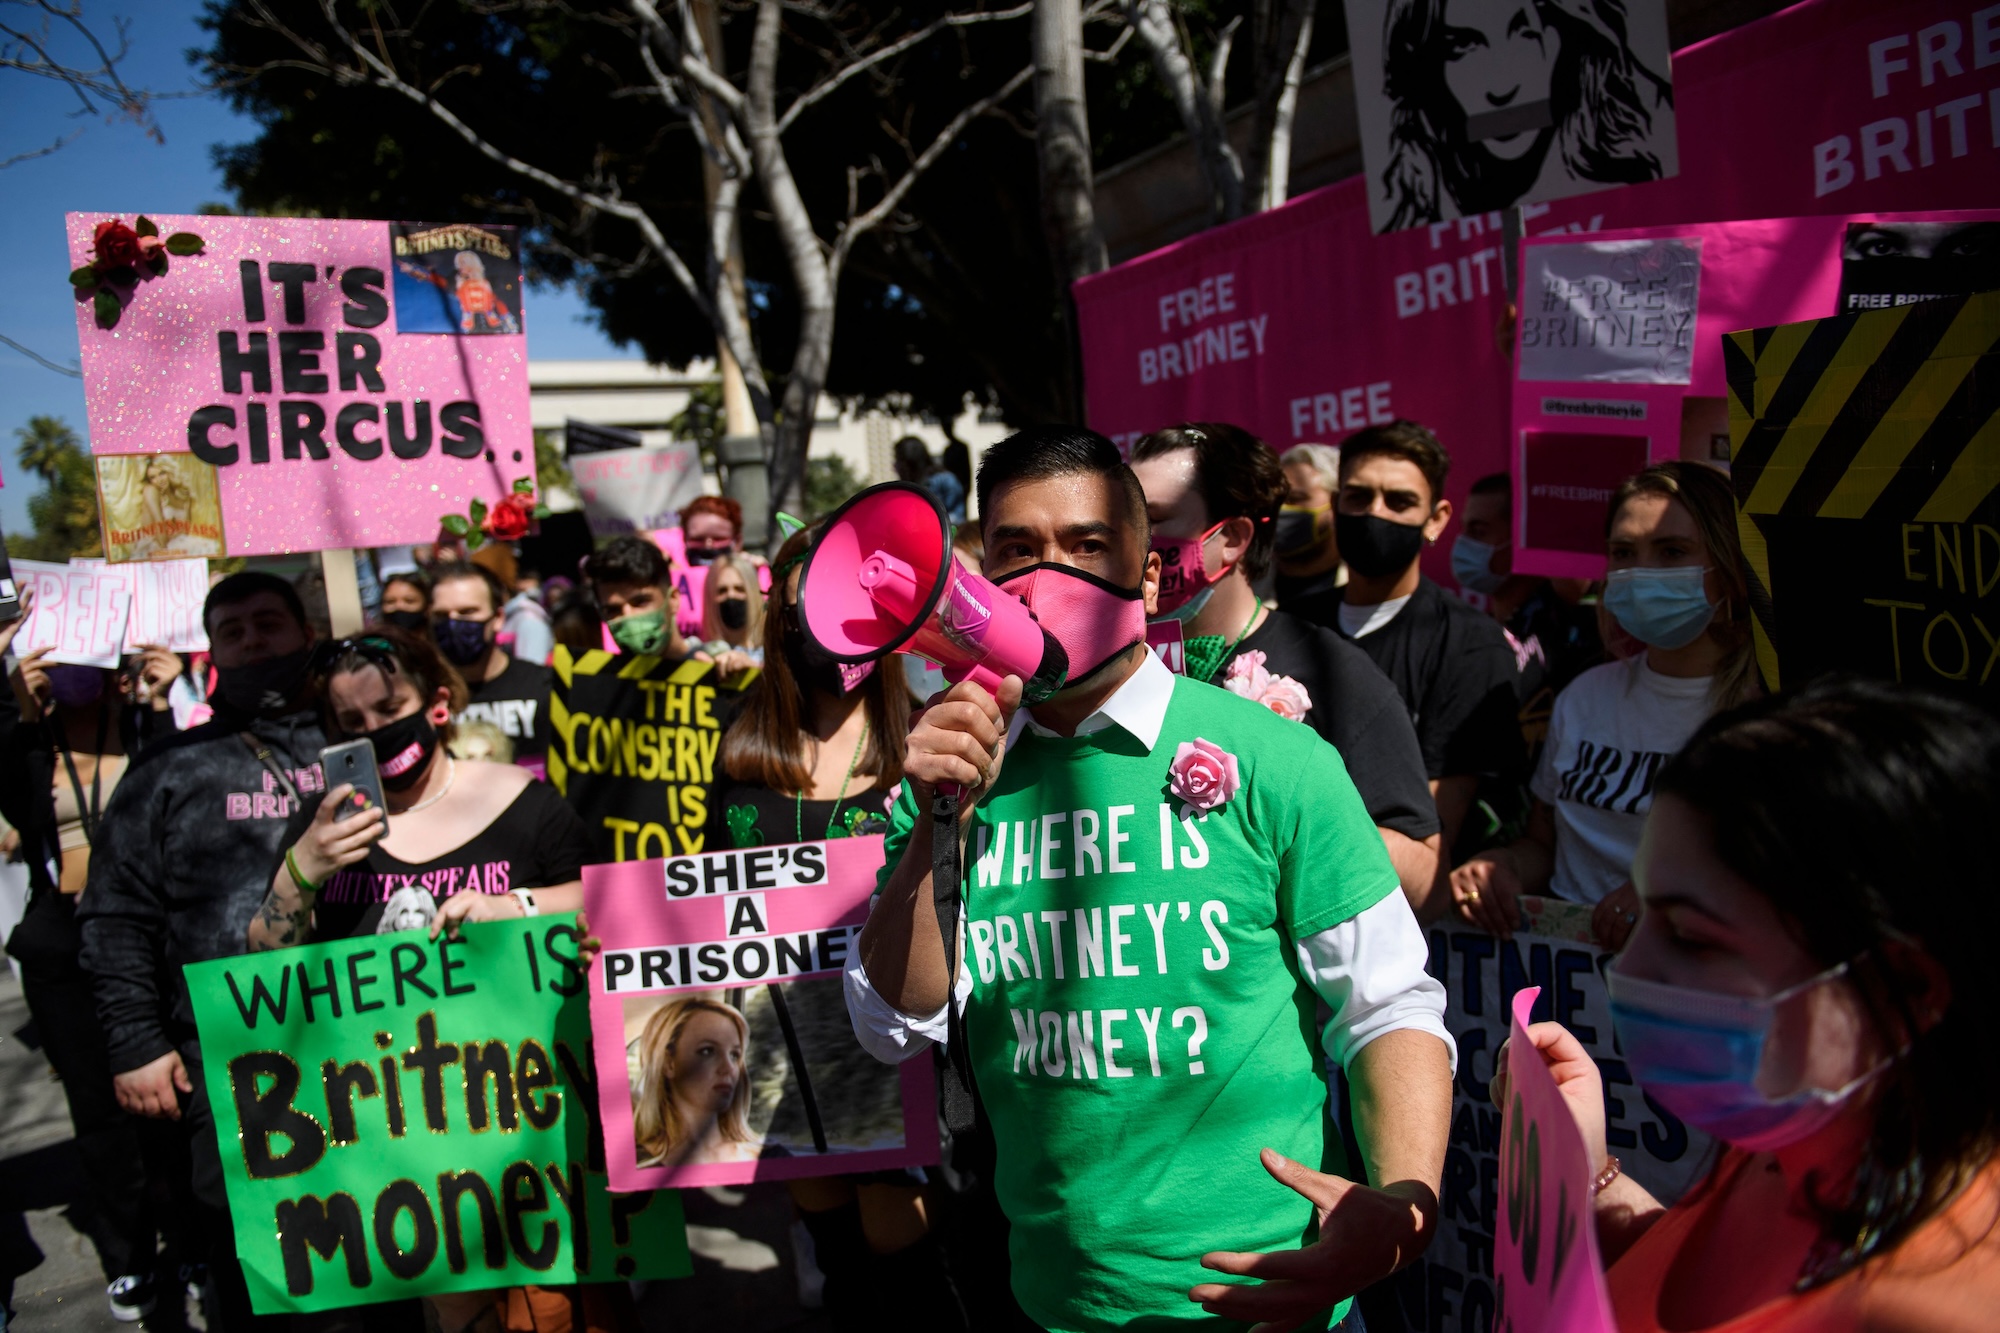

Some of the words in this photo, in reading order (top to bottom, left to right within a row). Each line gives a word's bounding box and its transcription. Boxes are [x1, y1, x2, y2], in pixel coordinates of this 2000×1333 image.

[1813, 88, 2000, 199] BRIT
[240, 260, 388, 328] IT'S
[1158, 272, 1237, 334] FREE
[1541, 277, 1669, 313] #FREE
[1848, 293, 1893, 309] FREE
[1138, 313, 1269, 386] BRITNEY
[1522, 312, 1691, 349] BRITNEY
[218, 331, 386, 394] HER
[1289, 381, 1395, 438] FREE
[1902, 522, 2000, 598] END
[638, 680, 719, 729] THE
[667, 785, 708, 829] IS
[667, 846, 826, 897] SHE'S
[977, 804, 1136, 888] WHERE
[1159, 803, 1210, 871] IS
[420, 860, 511, 899] SPEARS
[729, 897, 766, 936] A
[968, 900, 1230, 984] BRITNEY'S
[225, 935, 476, 1029] WHERE
[524, 924, 587, 998] IS
[604, 927, 863, 992] PRISONE
[1429, 930, 1616, 1046] ITNE
[1012, 1006, 1208, 1080] MONEY?
